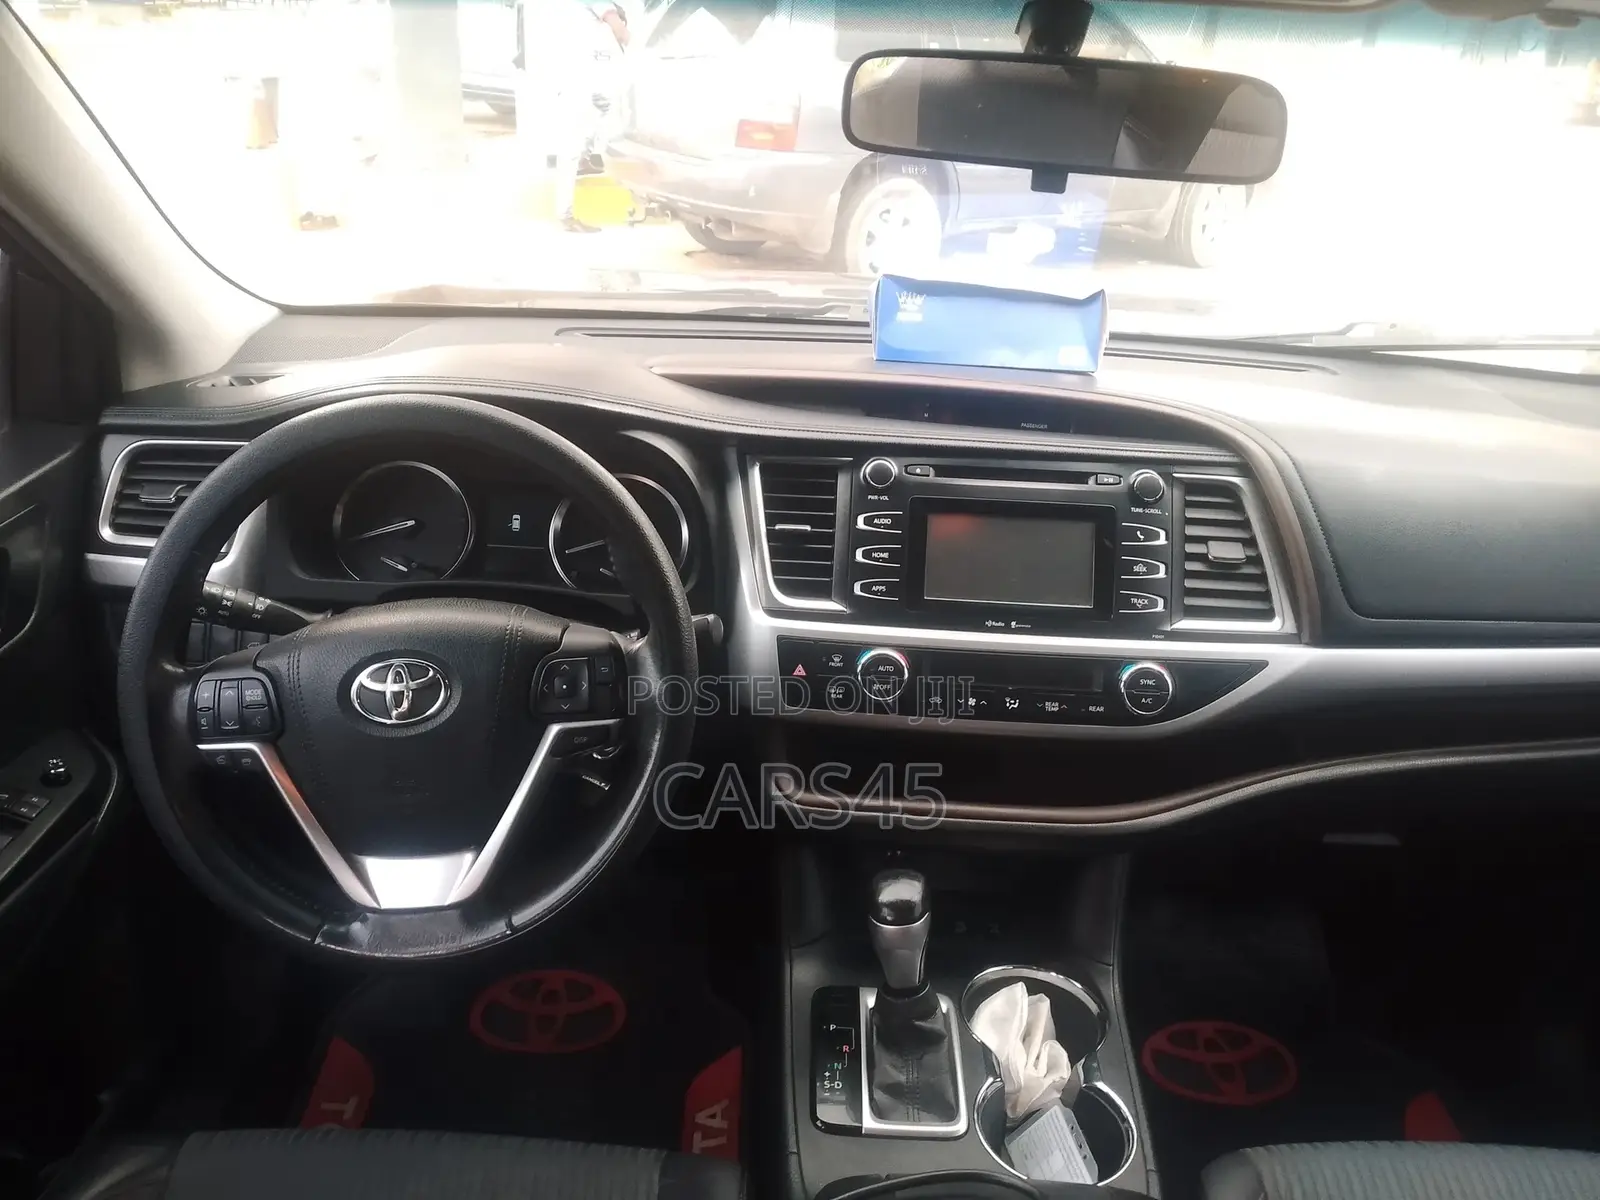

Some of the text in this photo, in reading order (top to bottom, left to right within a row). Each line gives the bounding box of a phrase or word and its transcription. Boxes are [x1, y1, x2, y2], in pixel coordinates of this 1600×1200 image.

[873, 517, 892, 525] AUDIO
[871, 551, 889, 559] HOME
[1133, 565, 1148, 573] SEEK
[1130, 597, 1149, 605] TRACK
[877, 665, 895, 673] AUTO
[1140, 678, 1156, 686] SYNC
[880, 683, 892, 691] OFF
[842, 1045, 850, 1053] R
[833, 1062, 842, 1070] N
